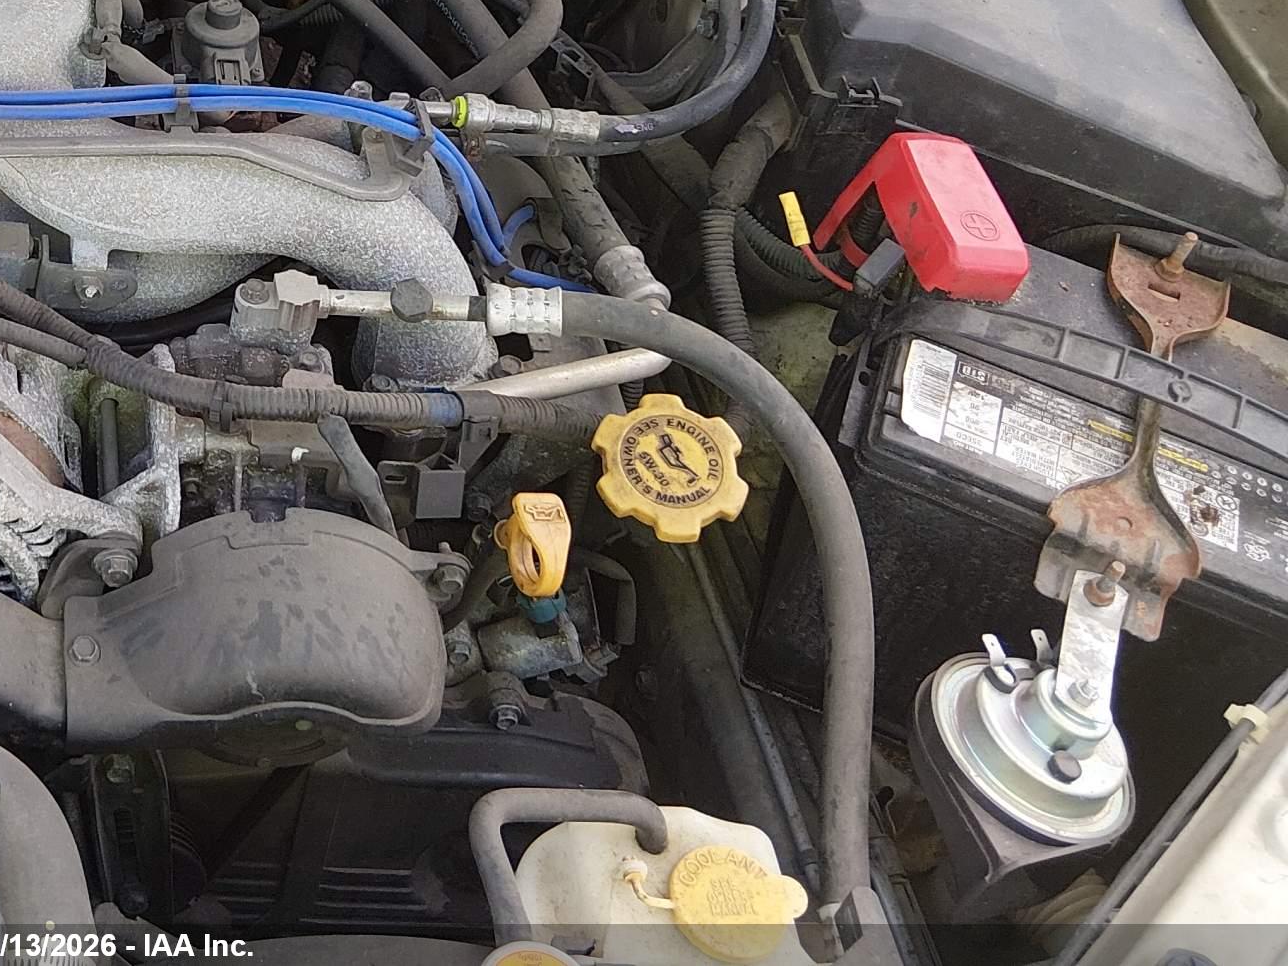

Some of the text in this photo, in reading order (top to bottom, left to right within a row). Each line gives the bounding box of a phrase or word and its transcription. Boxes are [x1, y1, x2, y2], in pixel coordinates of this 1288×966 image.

[623, 418, 711, 504] SEE OWNER'S MANUAL
[638, 451, 671, 488] 5W-30
[666, 417, 719, 481] ENGINE OIL
[679, 849, 767, 886] COOLANT
